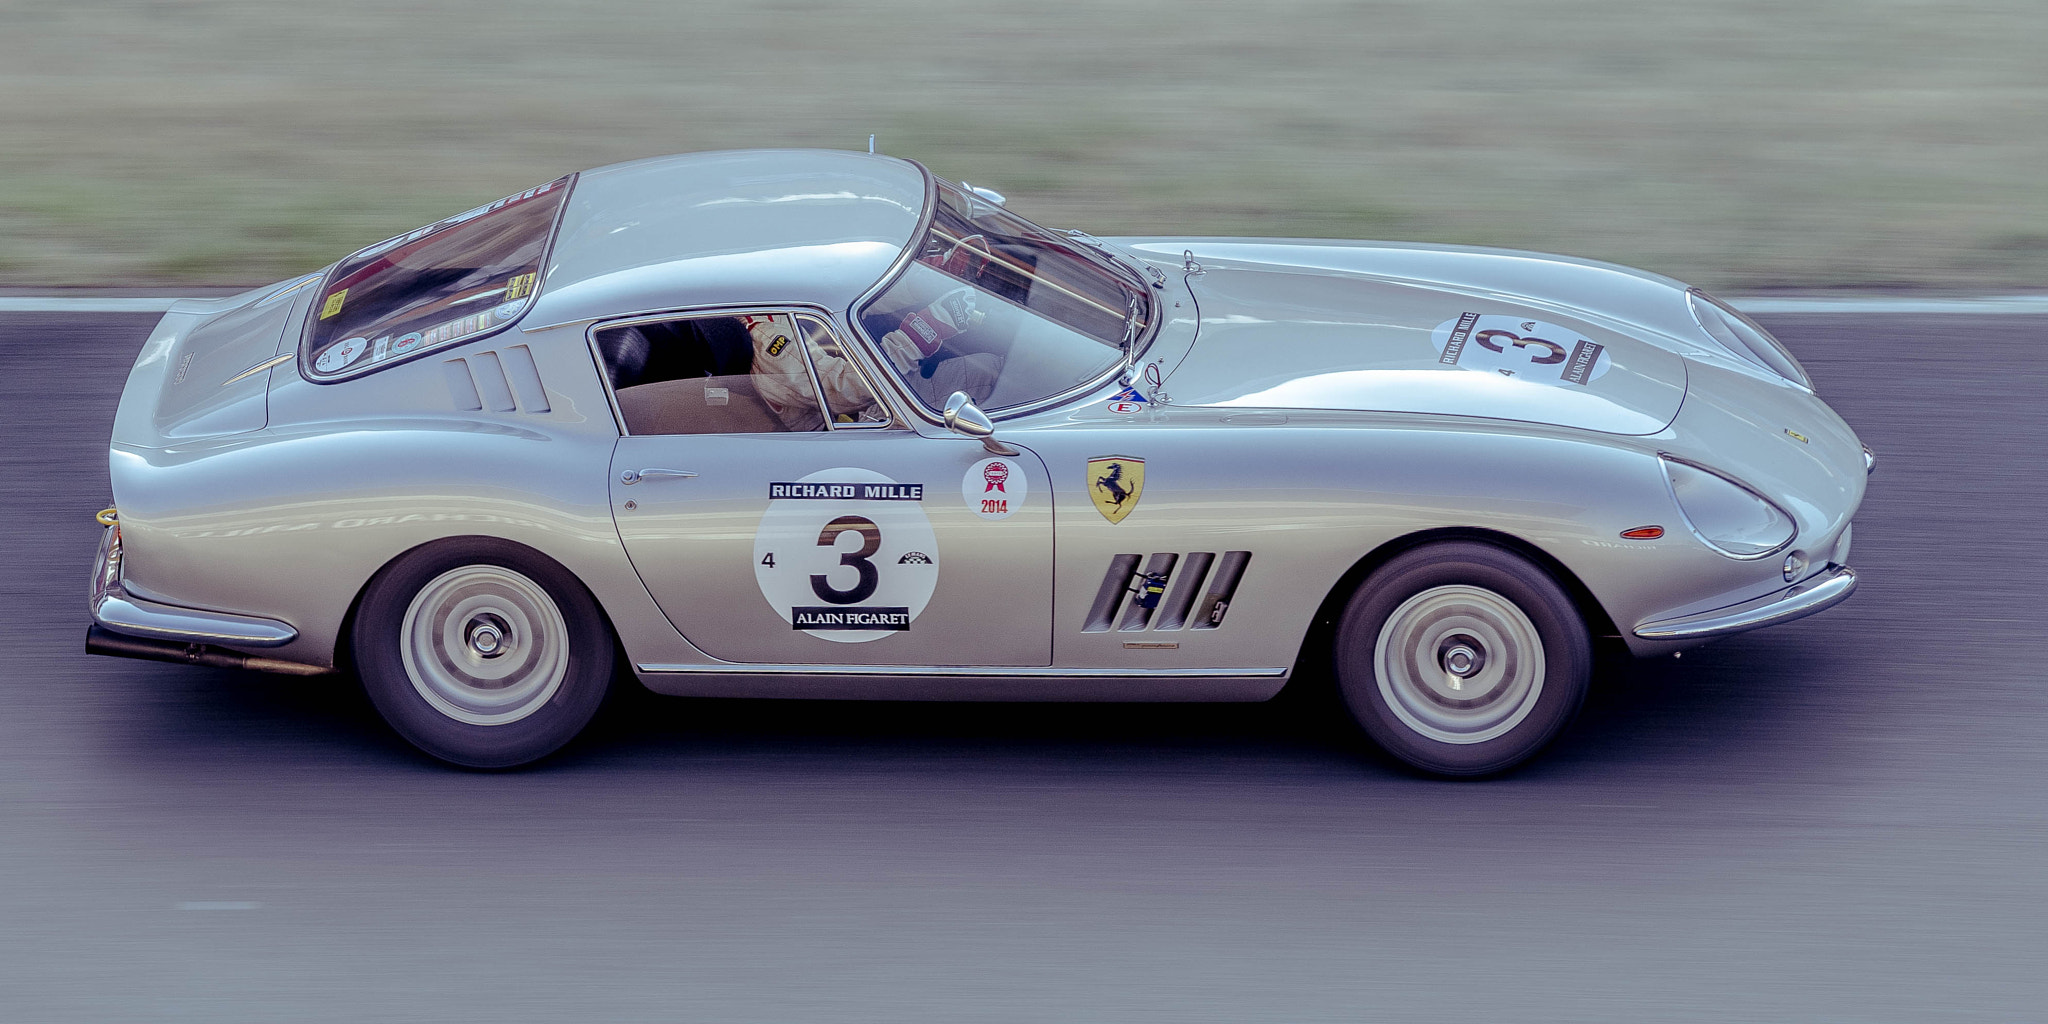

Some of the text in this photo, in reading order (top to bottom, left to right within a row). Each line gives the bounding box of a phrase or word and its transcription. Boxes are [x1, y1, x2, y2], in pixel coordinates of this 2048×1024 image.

[769, 336, 787, 356] OMP
[1442, 312, 1477, 364] RICHARD MILLE
[1474, 329, 1567, 365] 3
[1498, 368, 1516, 377] 4
[772, 485, 922, 499] RICHARD MILLE
[981, 499, 1008, 514] 2014
[761, 552, 776, 568] 4
[809, 515, 882, 605] 3
[796, 613, 909, 625] ALAIN FIGARET
